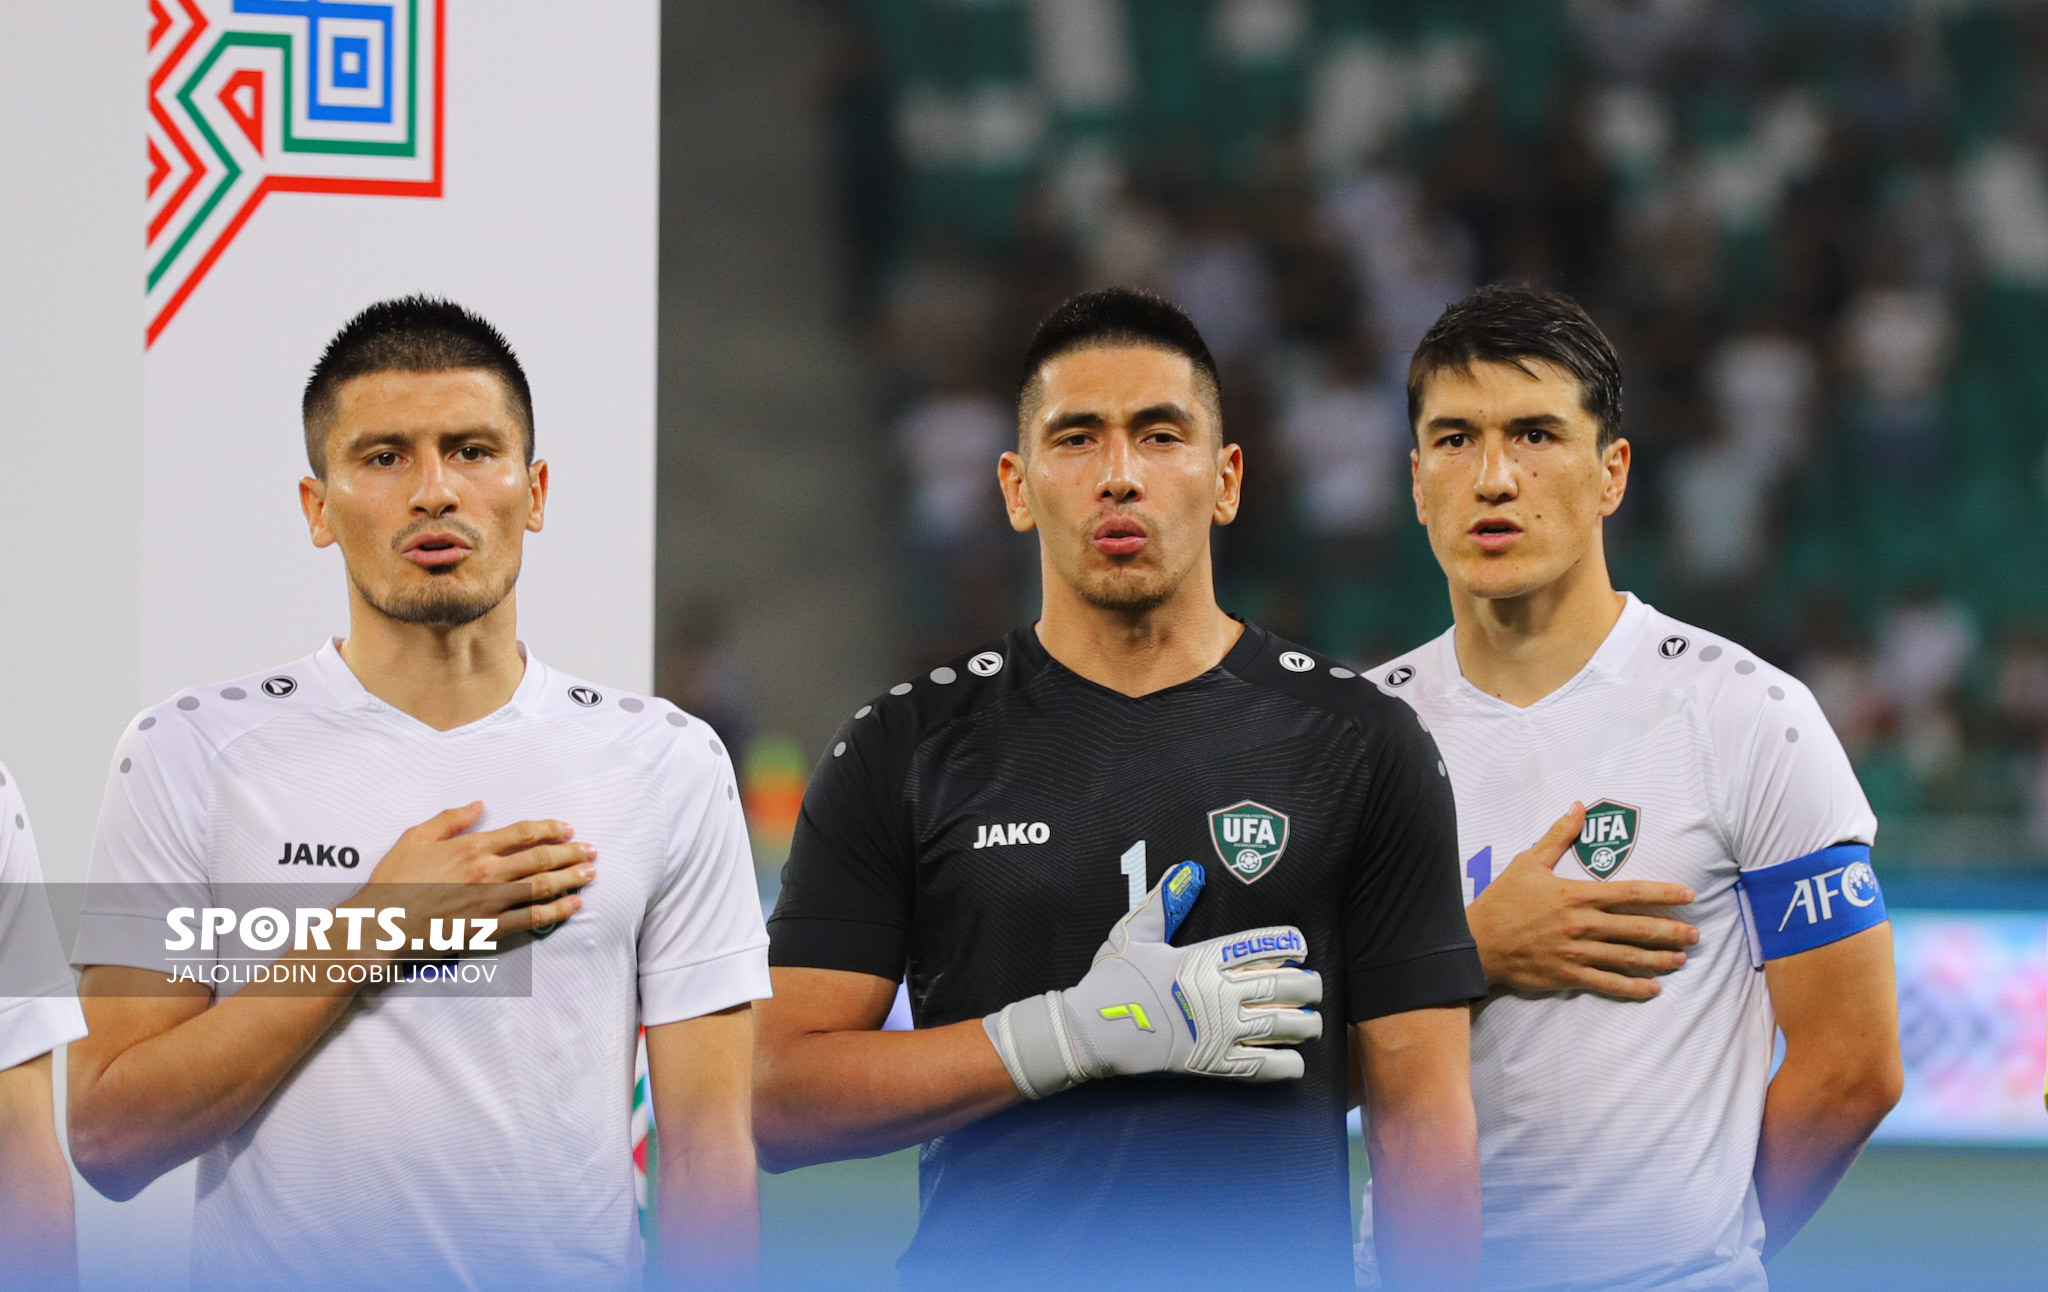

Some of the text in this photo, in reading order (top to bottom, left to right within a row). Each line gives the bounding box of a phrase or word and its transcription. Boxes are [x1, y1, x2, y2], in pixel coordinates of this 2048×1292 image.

[973, 822, 1051, 849] JAKO
[1223, 817, 1277, 846] UFA
[1580, 814, 1629, 845] UFA
[278, 843, 360, 869] JAKO
[1120, 840, 1148, 914] 1
[1778, 861, 1879, 932] AFC
[1222, 930, 1301, 962] reusch
